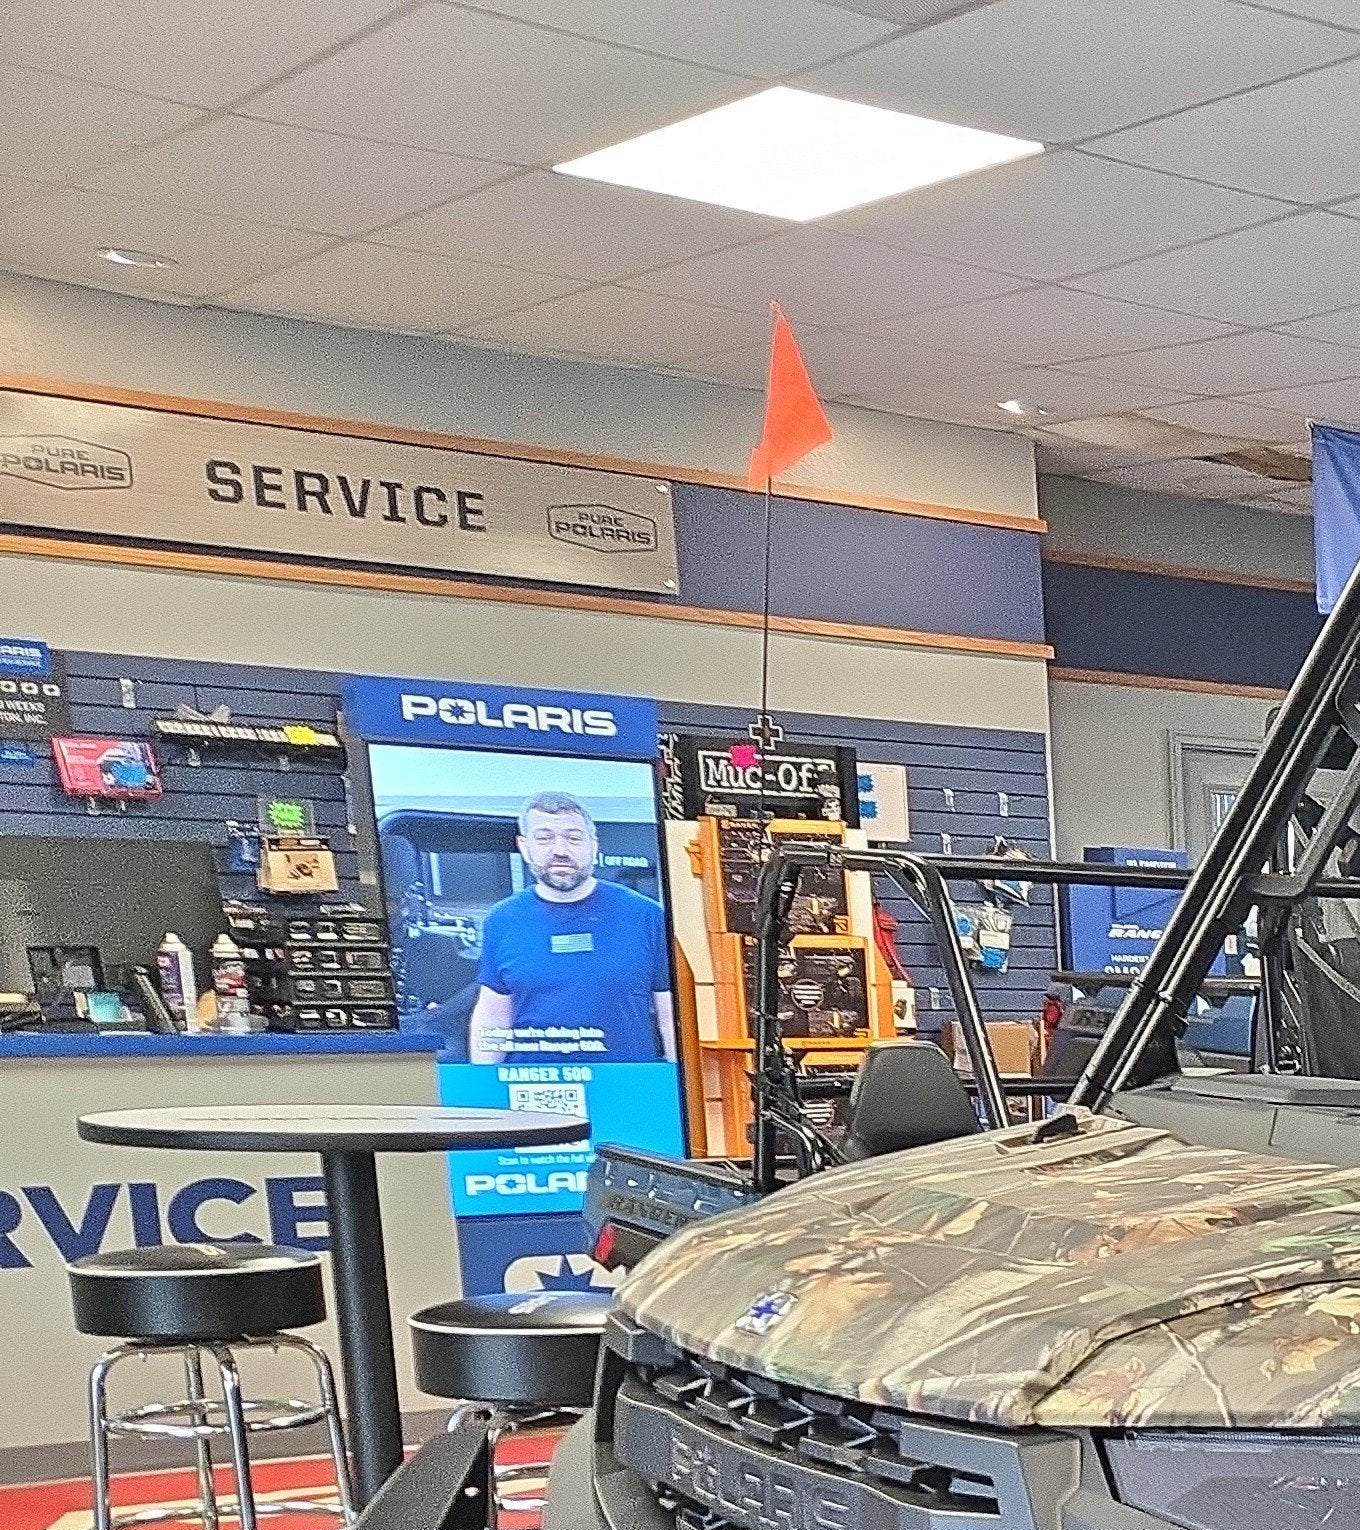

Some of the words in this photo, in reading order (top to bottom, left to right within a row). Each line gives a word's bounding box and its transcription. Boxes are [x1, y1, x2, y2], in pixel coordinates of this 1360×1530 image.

[31, 444, 90, 461] PURE
[0, 453, 125, 480] POLARIS
[205, 458, 488, 533] SERVICE
[579, 512, 623, 527] PURE
[555, 521, 652, 544] POLARIS
[401, 693, 618, 737] POLARIS
[705, 757, 831, 793] Muc-Of
[1108, 928, 1163, 939] RANG
[498, 1067, 560, 1082] RANGER
[563, 1067, 592, 1082] 500
[465, 1171, 588, 1196] POLA
